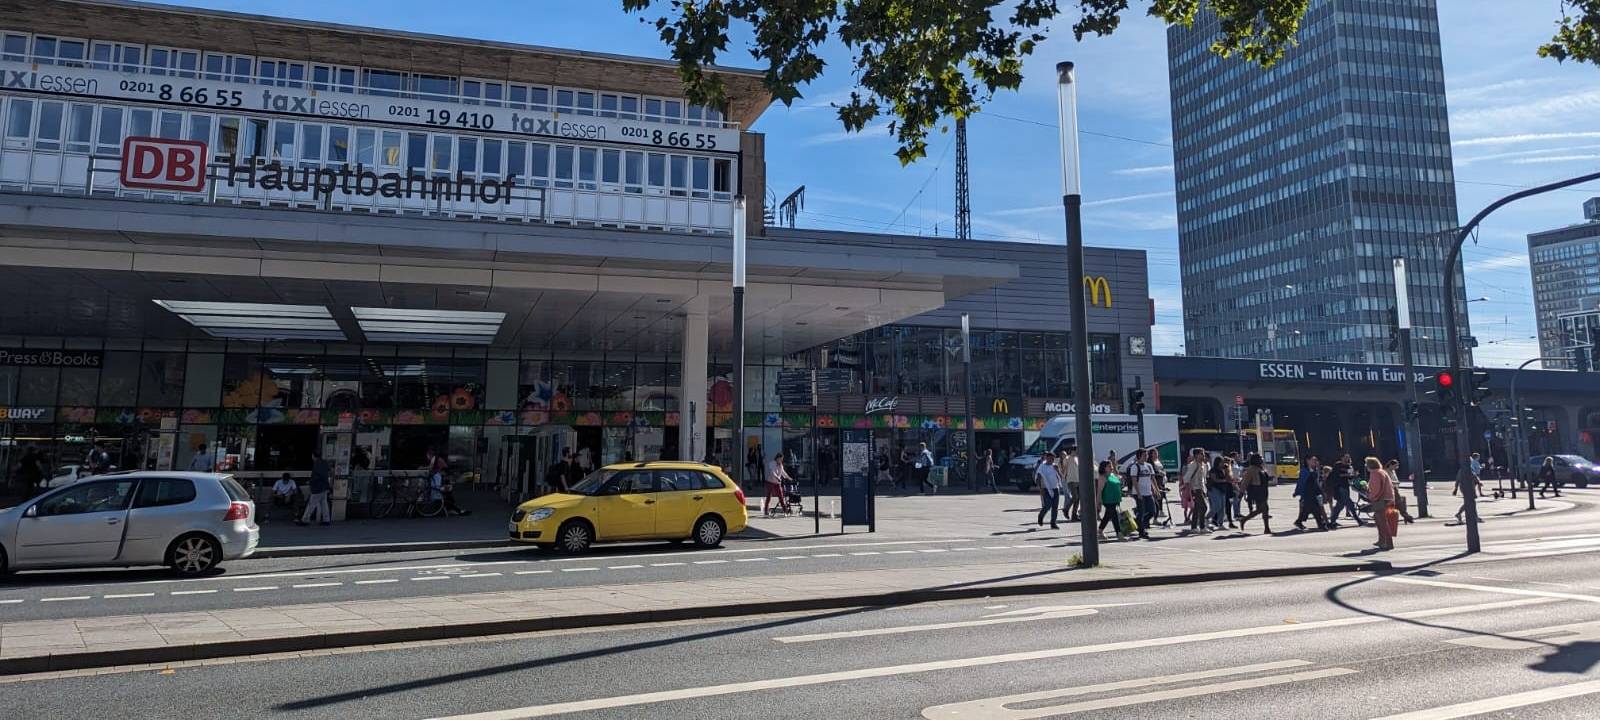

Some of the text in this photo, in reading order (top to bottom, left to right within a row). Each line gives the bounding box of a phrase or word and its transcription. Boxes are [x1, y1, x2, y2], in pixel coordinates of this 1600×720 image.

[119, 80, 243, 107] 0201 8 66 55
[388, 105, 494, 129] 0201 19 410
[621, 126, 716, 149] 0201 8 66 55
[132, 144, 195, 182] DB
[227, 153, 517, 204] Hauptbahnhof
[1260, 363, 1304, 378] ESSEN
[1320, 365, 1362, 381] mitten
[1366, 367, 1379, 381] in
